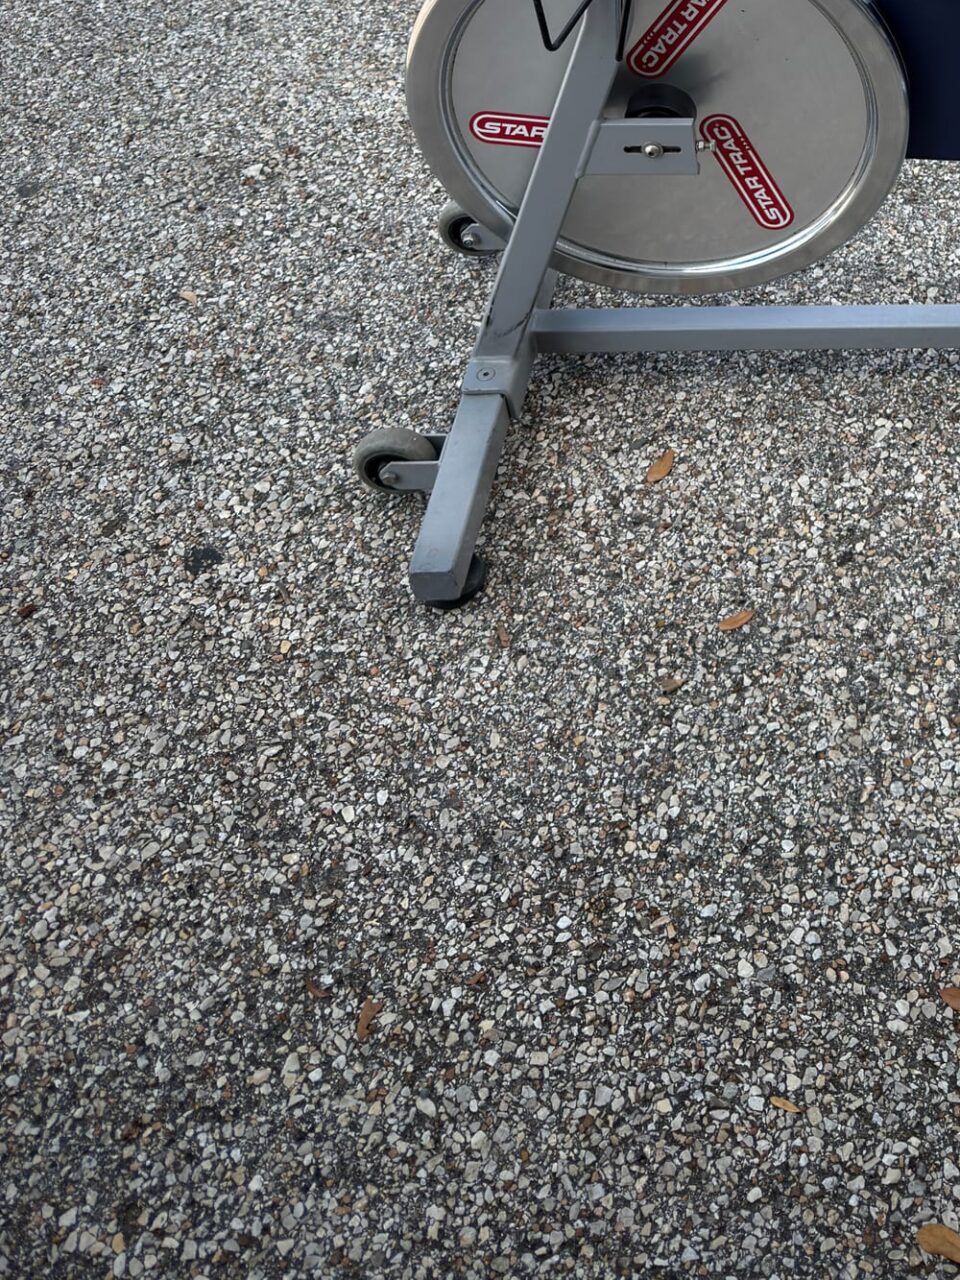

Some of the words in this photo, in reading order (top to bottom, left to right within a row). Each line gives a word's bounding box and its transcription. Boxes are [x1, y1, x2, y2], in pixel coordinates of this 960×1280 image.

[641, 20, 688, 68] TRAC
[713, 126, 752, 176] TRAC
[744, 176, 784, 223] STAR
